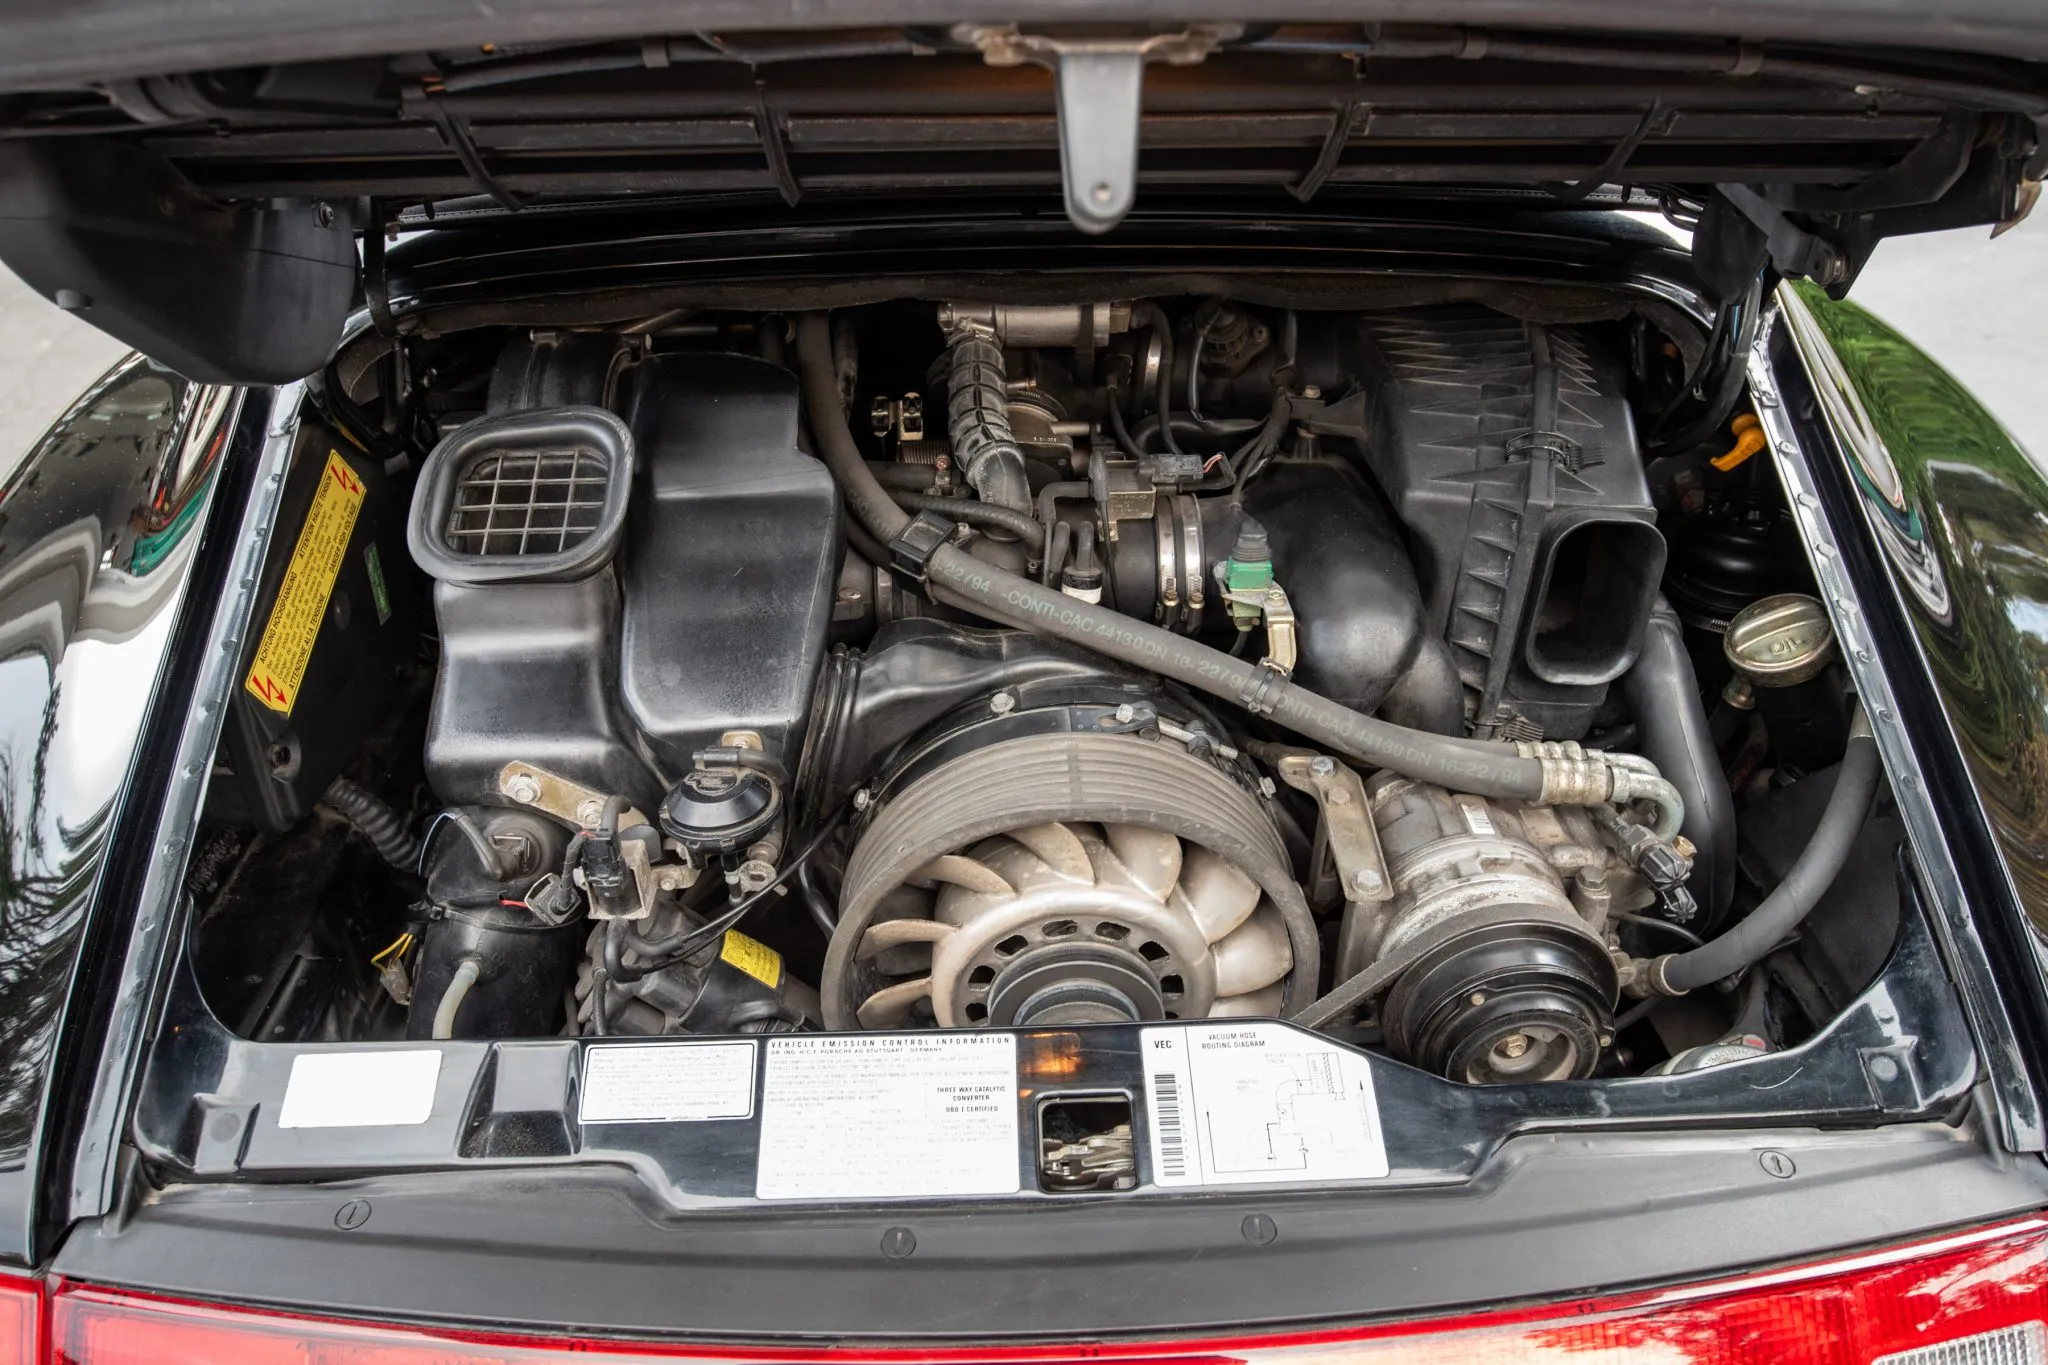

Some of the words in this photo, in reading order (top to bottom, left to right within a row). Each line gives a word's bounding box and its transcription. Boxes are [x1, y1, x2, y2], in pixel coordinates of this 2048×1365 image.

[298, 521, 315, 560] ATTENTION
[311, 499, 322, 524] HAUTE
[319, 473, 332, 502] TENSION
[328, 545, 341, 574] DANGER
[337, 529, 346, 547] HIGH
[343, 501, 356, 532] VOLTAGE
[259, 627, 276, 664] ACHTUNG
[272, 570, 297, 629] HOCHSPANNUNG
[288, 645, 307, 690] ATTENZIONE
[303, 625, 314, 646] ALTA
[310, 591, 325, 627] TENSIONE
[1769, 637, 1803, 655] OIL
[771, 1040, 815, 1048] VEHICLE
[822, 1039, 875, 1048] EMISSION
[882, 1039, 929, 1047] CONTROL
[936, 1037, 1010, 1045] INFORMATION
[1154, 1040, 1172, 1049] VEC
[1201, 1042, 1232, 1050] ROUTING
[1234, 1040, 1266, 1048] DIAGRAM
[1209, 1032, 1237, 1040] VACUUM
